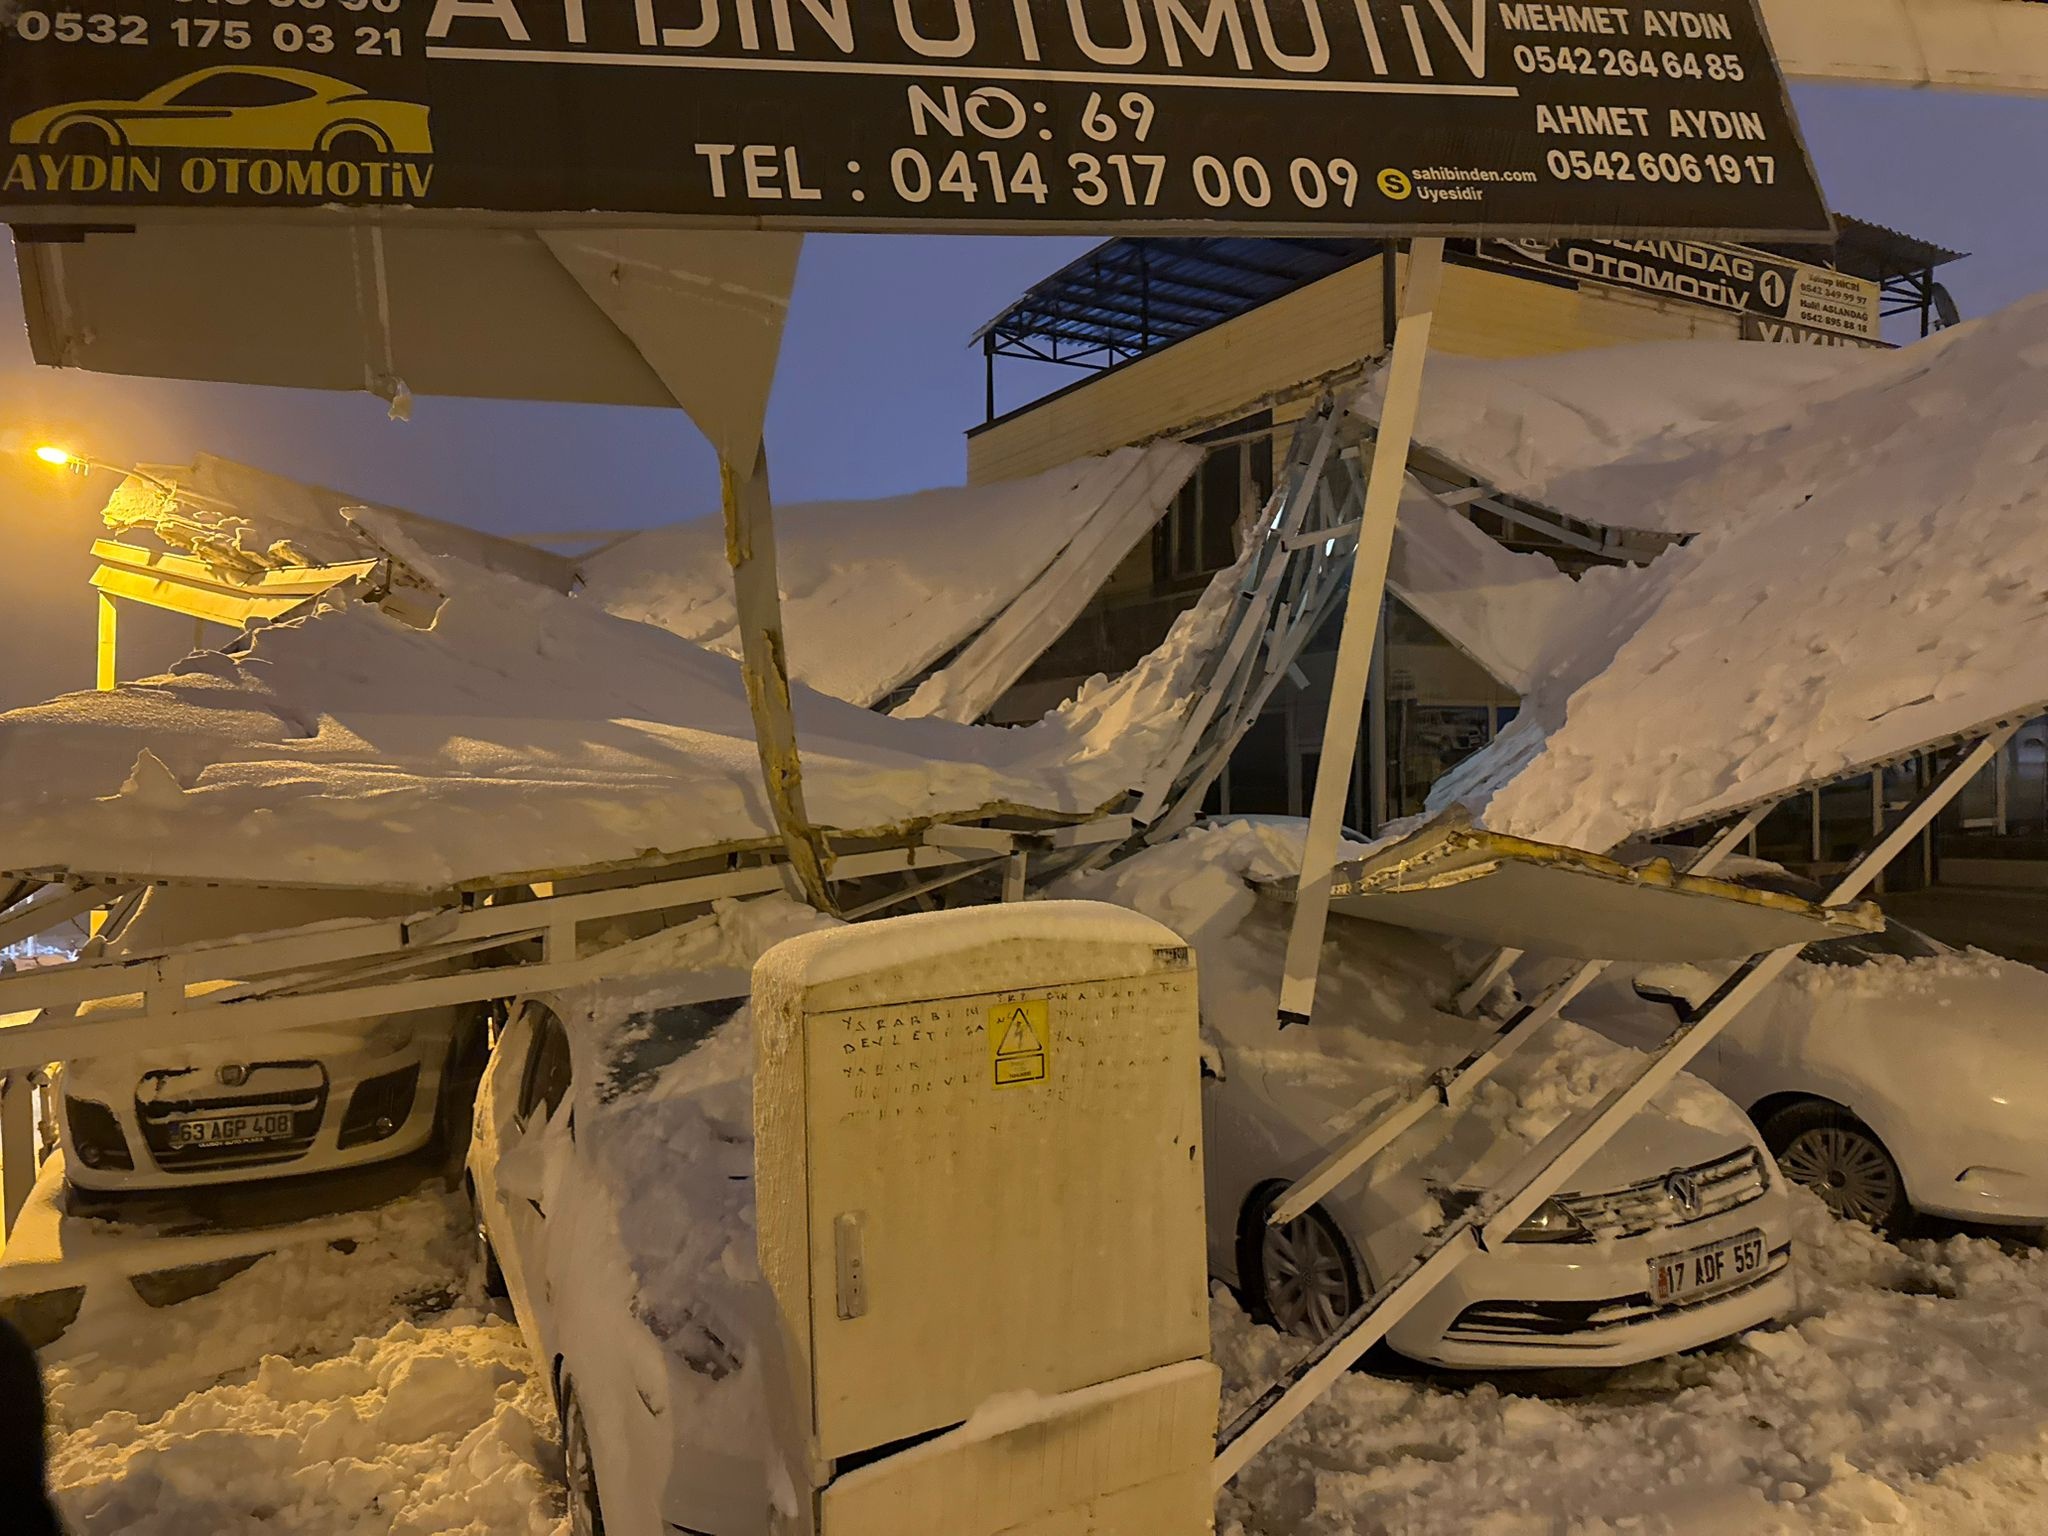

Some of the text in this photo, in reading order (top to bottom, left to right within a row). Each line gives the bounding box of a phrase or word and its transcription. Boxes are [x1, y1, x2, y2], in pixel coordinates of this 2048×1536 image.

[17, 11, 402, 56] 0532 175 03 21
[1499, 3, 1732, 40] MEHMET AYDIN
[1513, 45, 1744, 82] 0542 264 64 85
[907, 85, 1155, 142] NO: 69
[1536, 105, 1766, 141] AHMET AYDIN
[3, 154, 160, 192] AYDIN
[694, 143, 822, 200] TEL
[890, 147, 1048, 204] 0414
[1067, 153, 1167, 206] 317
[1192, 155, 1272, 208] 00
[1289, 157, 1358, 208] 09
[1412, 166, 1537, 183] sahibinden.com
[1547, 149, 1775, 185] 0542 606 19 17
[181, 1115, 289, 1141] 63 AGP 408
[1667, 1240, 1762, 1293] 17 ADF 557
